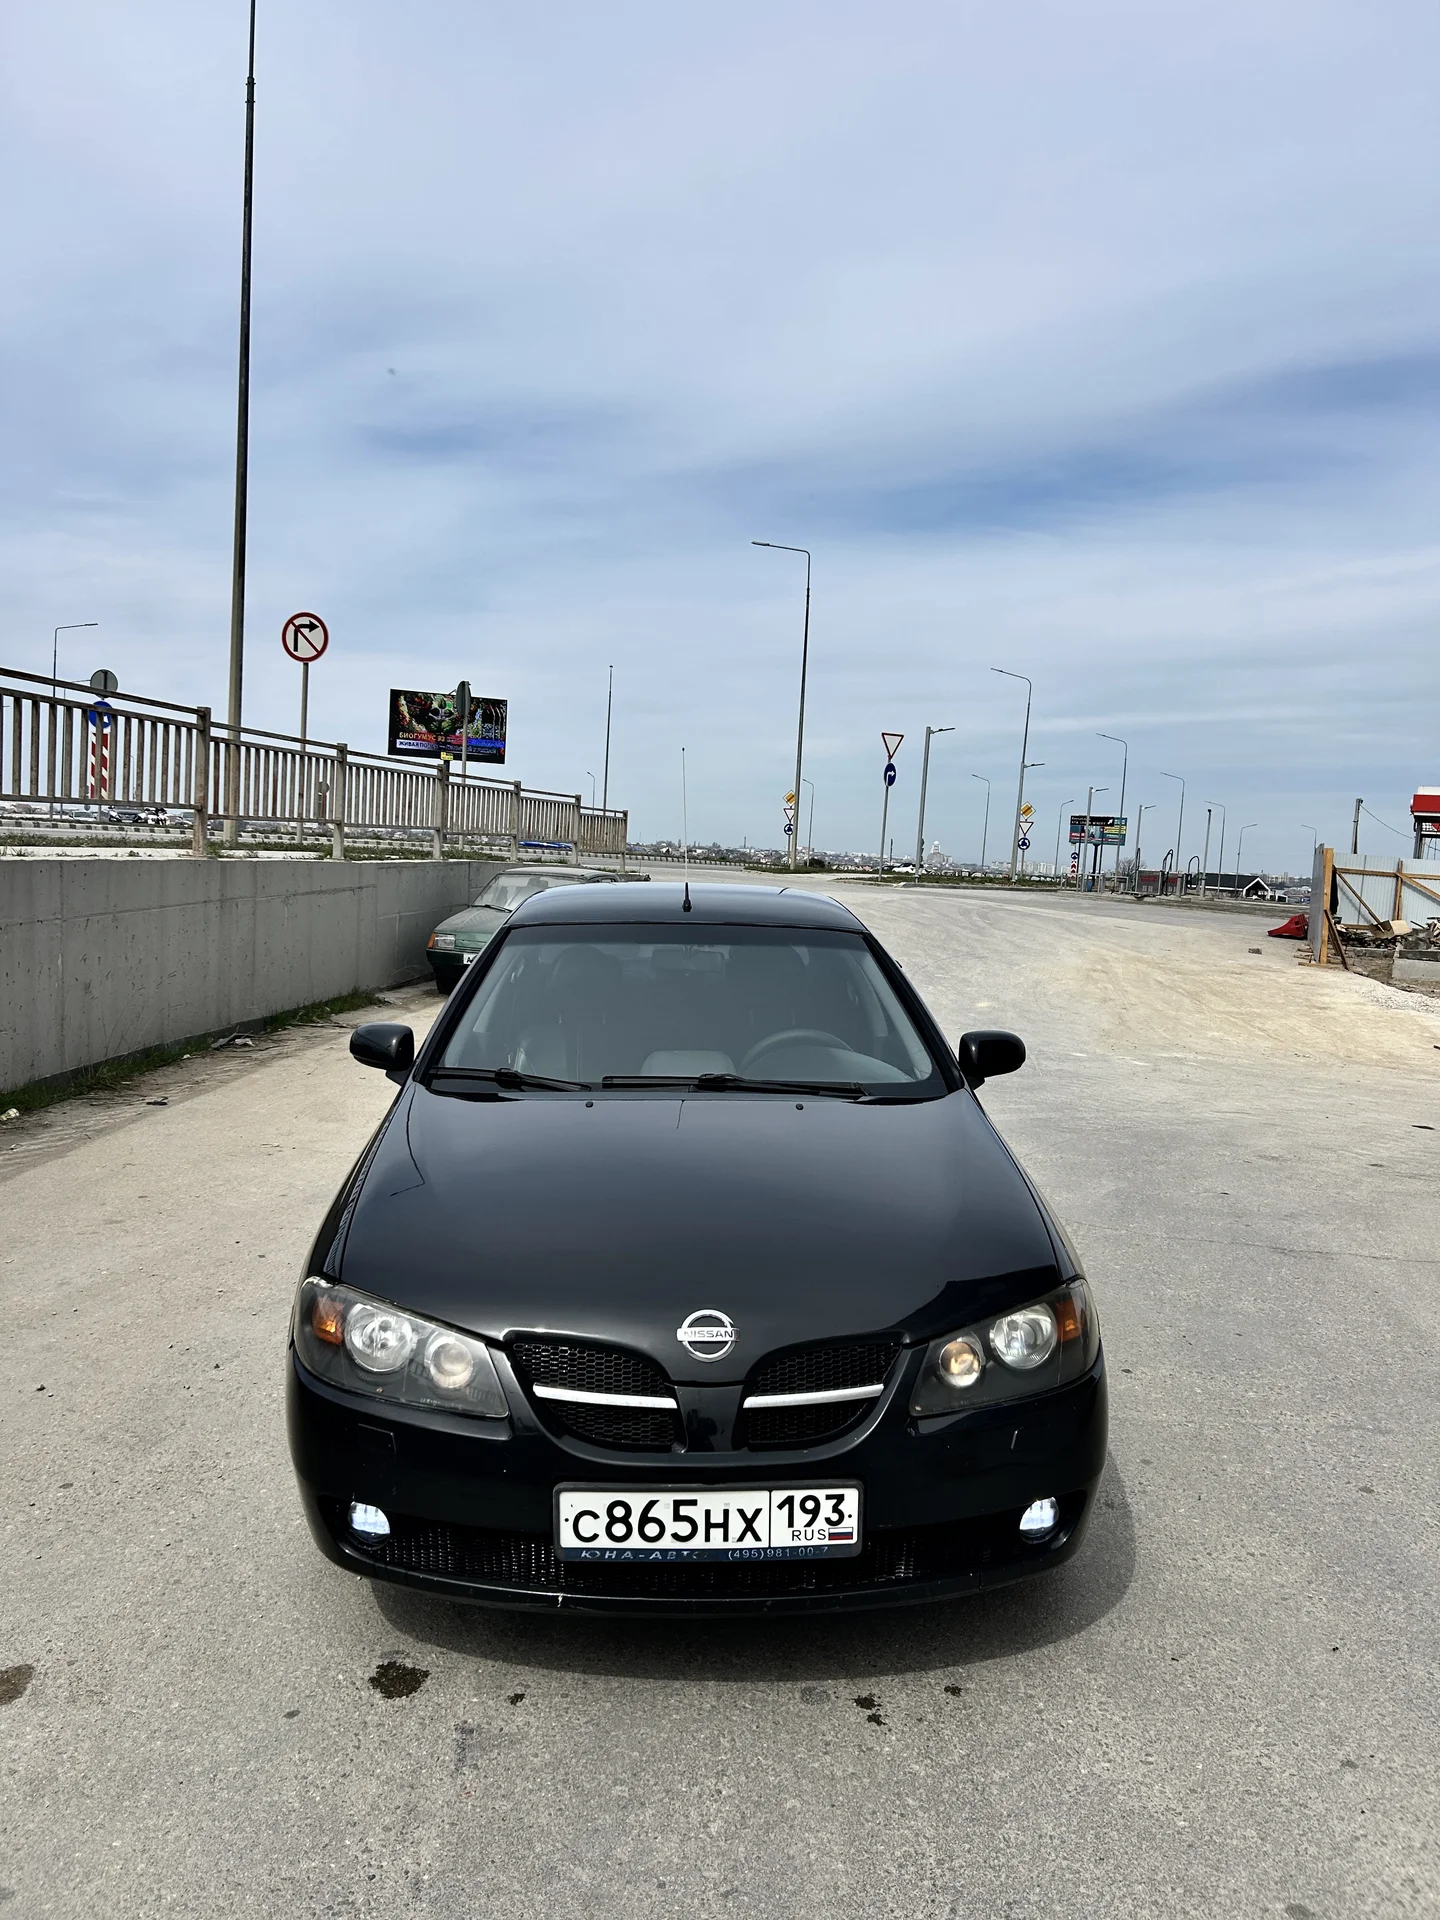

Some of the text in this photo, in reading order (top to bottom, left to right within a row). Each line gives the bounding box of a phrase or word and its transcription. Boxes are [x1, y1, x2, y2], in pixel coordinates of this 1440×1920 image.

[399, 732, 436, 741] БИОГУМУС
[684, 1330, 733, 1338] NISSAN
[572, 1493, 846, 1543] С865НХ 193
[791, 1528, 827, 1542] RUS
